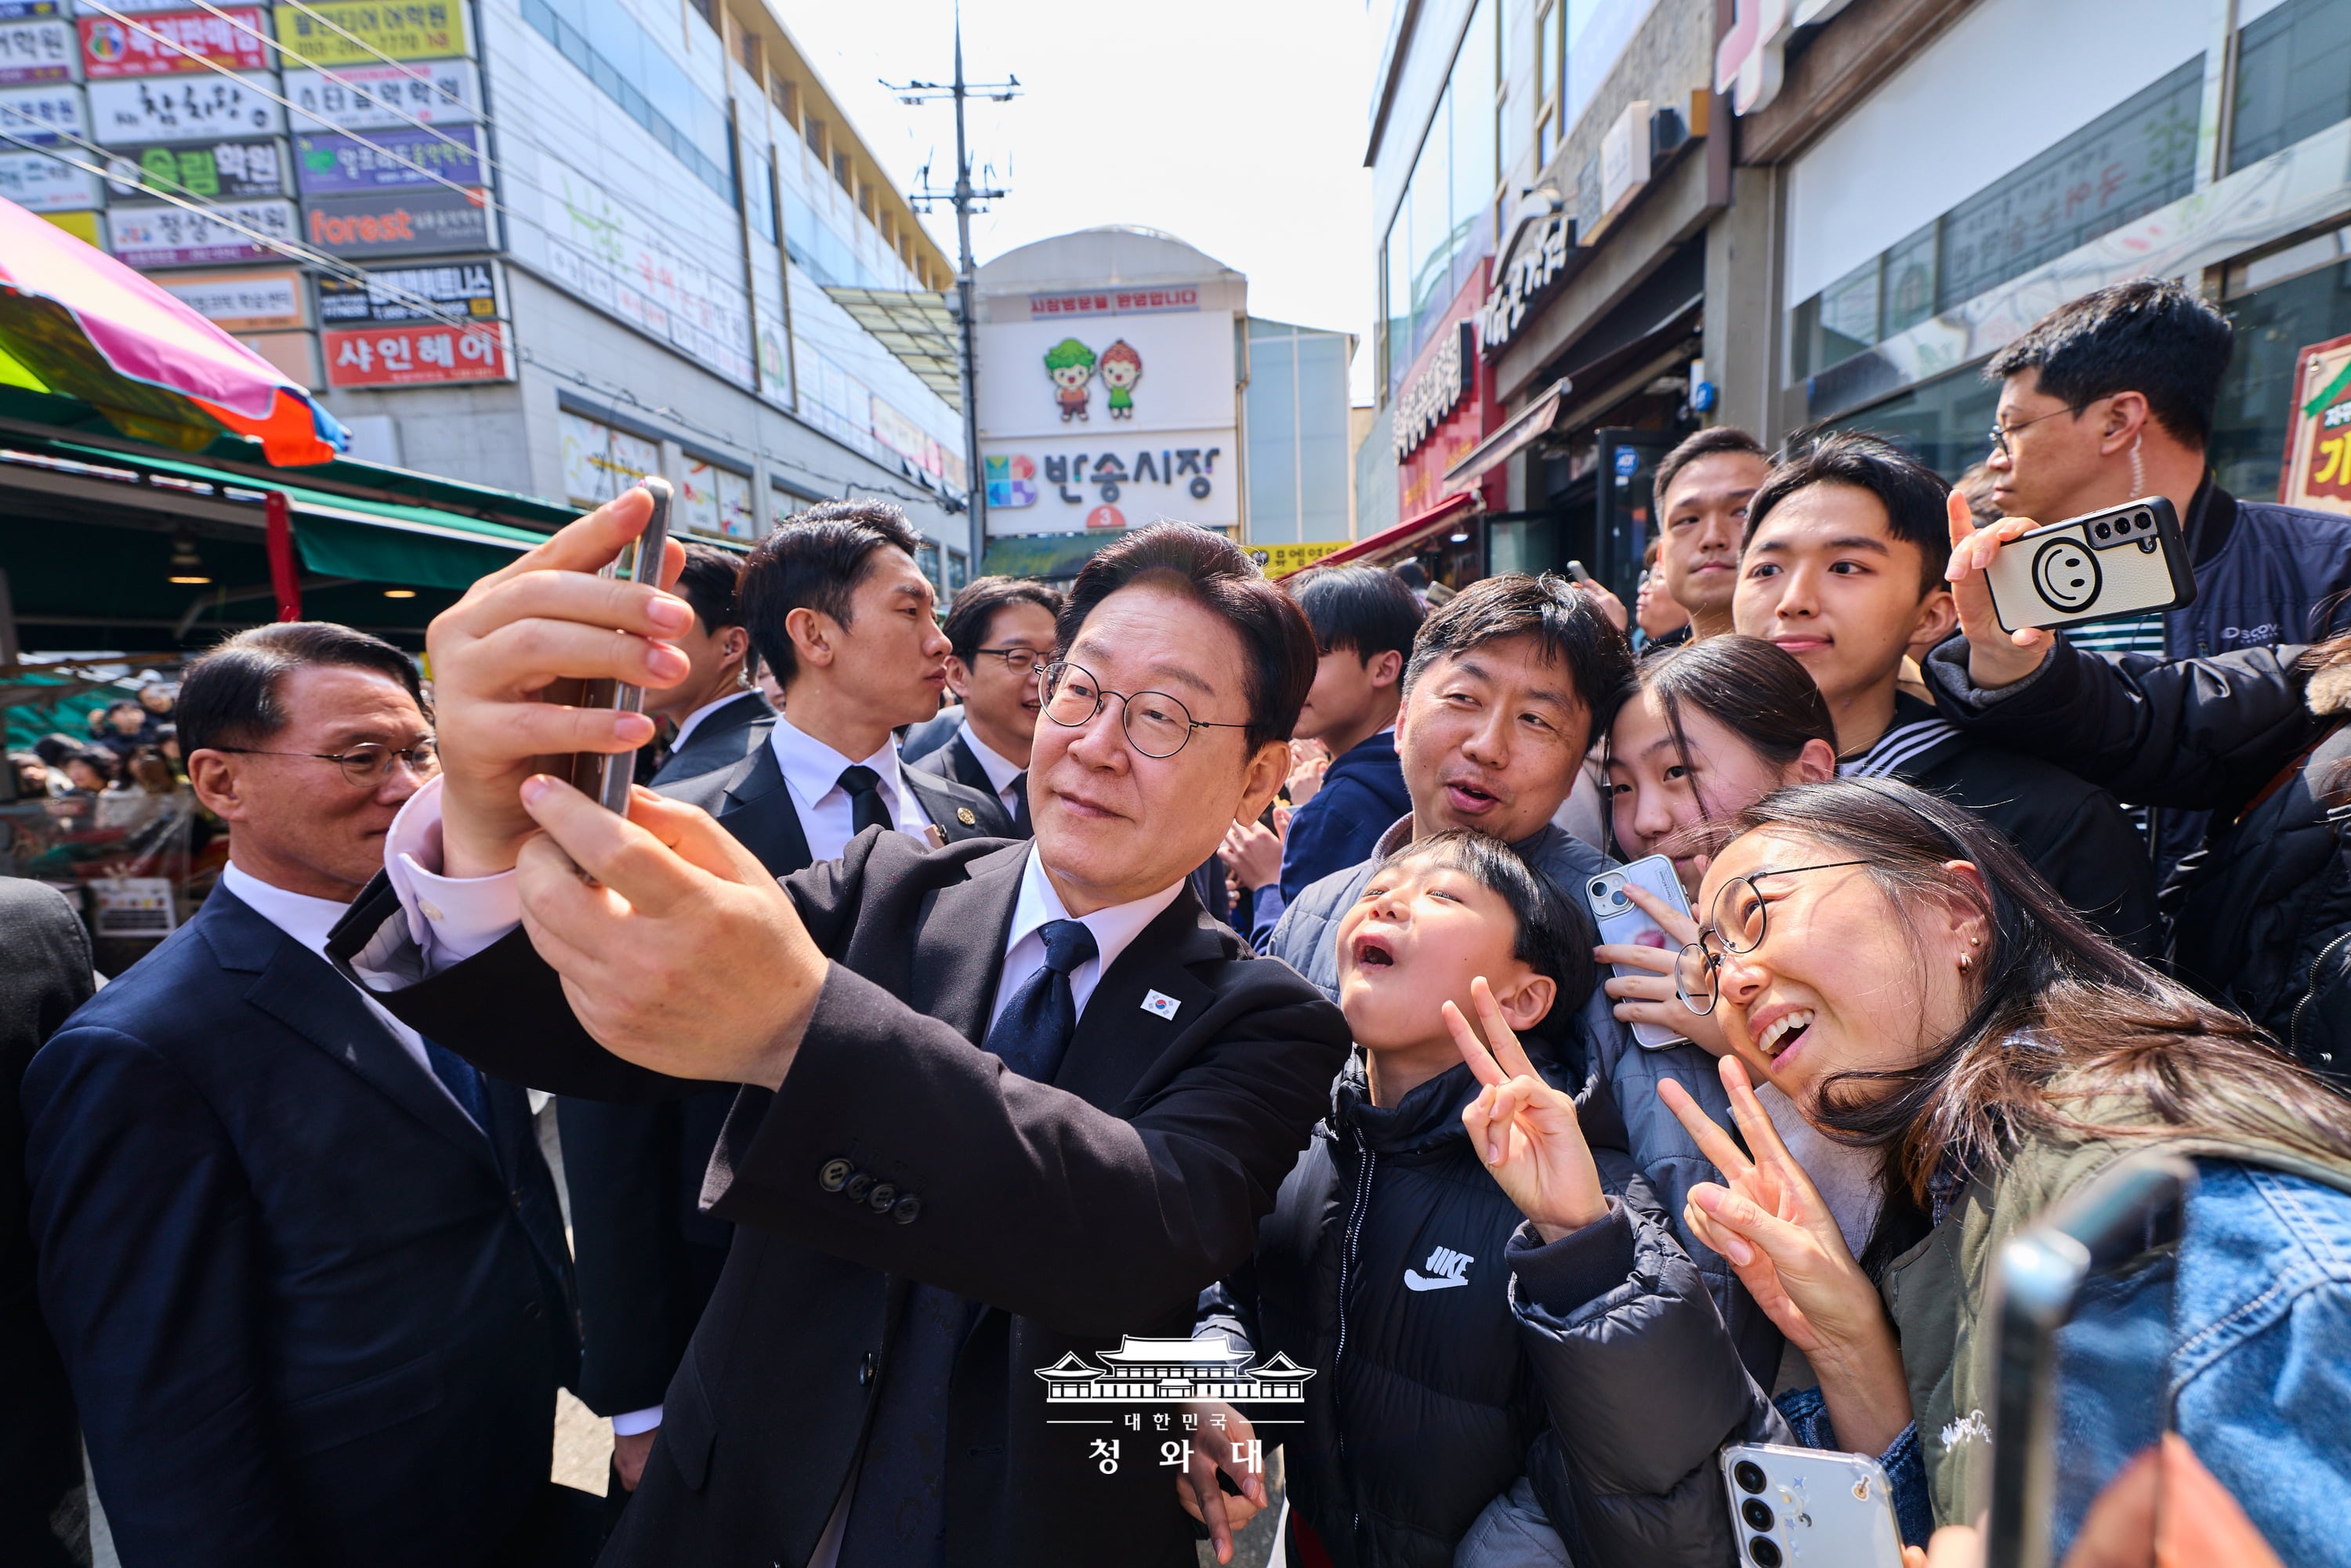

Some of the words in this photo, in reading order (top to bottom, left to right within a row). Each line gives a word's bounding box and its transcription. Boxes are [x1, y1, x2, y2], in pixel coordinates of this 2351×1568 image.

[310, 208, 414, 244] forest
[1116, 289, 1197, 308] 환영합니다
[335, 331, 494, 373] 샤인헤어
[1044, 447, 1221, 504] 반송시장
[1099, 508, 1113, 526] 3
[1425, 1246, 1474, 1279] NIKE
